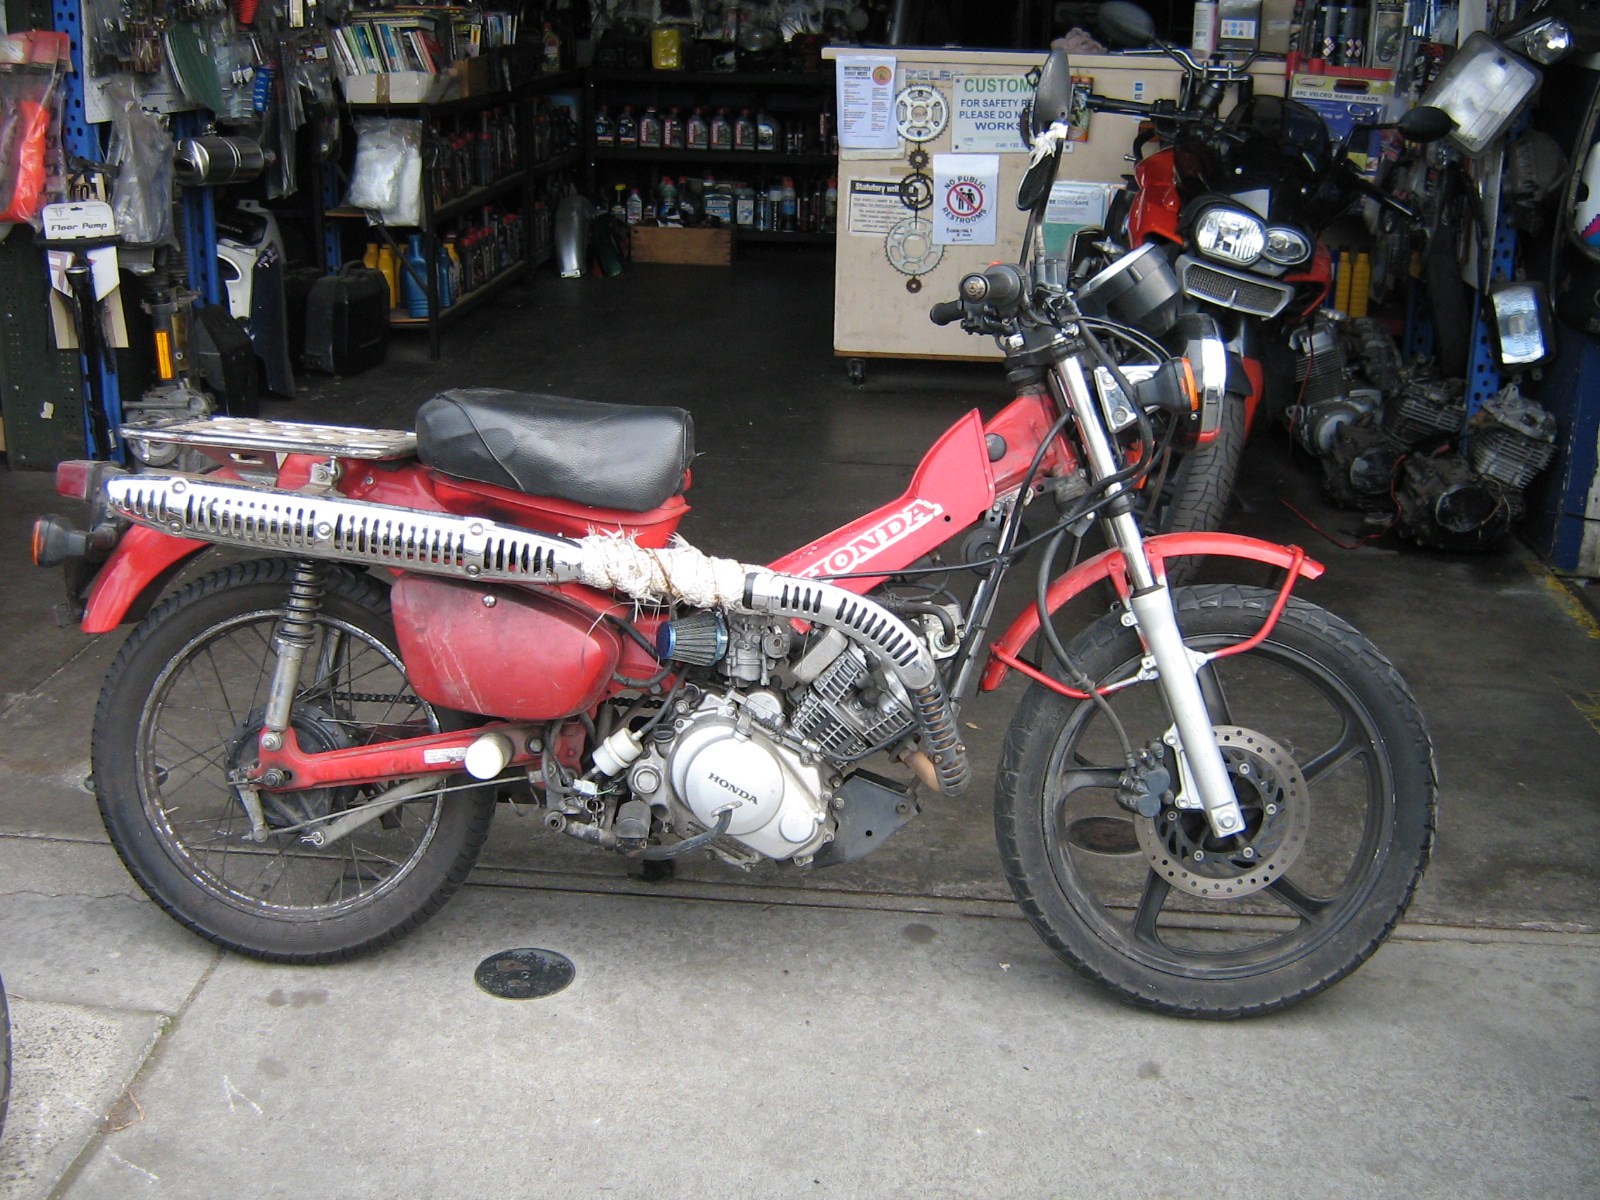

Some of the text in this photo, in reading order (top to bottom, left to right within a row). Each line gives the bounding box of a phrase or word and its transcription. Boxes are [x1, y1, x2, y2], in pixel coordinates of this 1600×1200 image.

[964, 78, 1036, 93] CUSTOM
[960, 99, 980, 108] FOR
[982, 99, 1019, 108] SAFETY
[959, 110, 996, 120] PLEASE
[998, 110, 1013, 119] DO
[975, 122, 1021, 131] WORKS
[944, 175, 987, 190] NO PUBLIC
[942, 206, 987, 224] RESTROOMS
[82, 222, 108, 230] Pump
[800, 500, 942, 580] HONDA
[707, 771, 758, 806] HONDA
